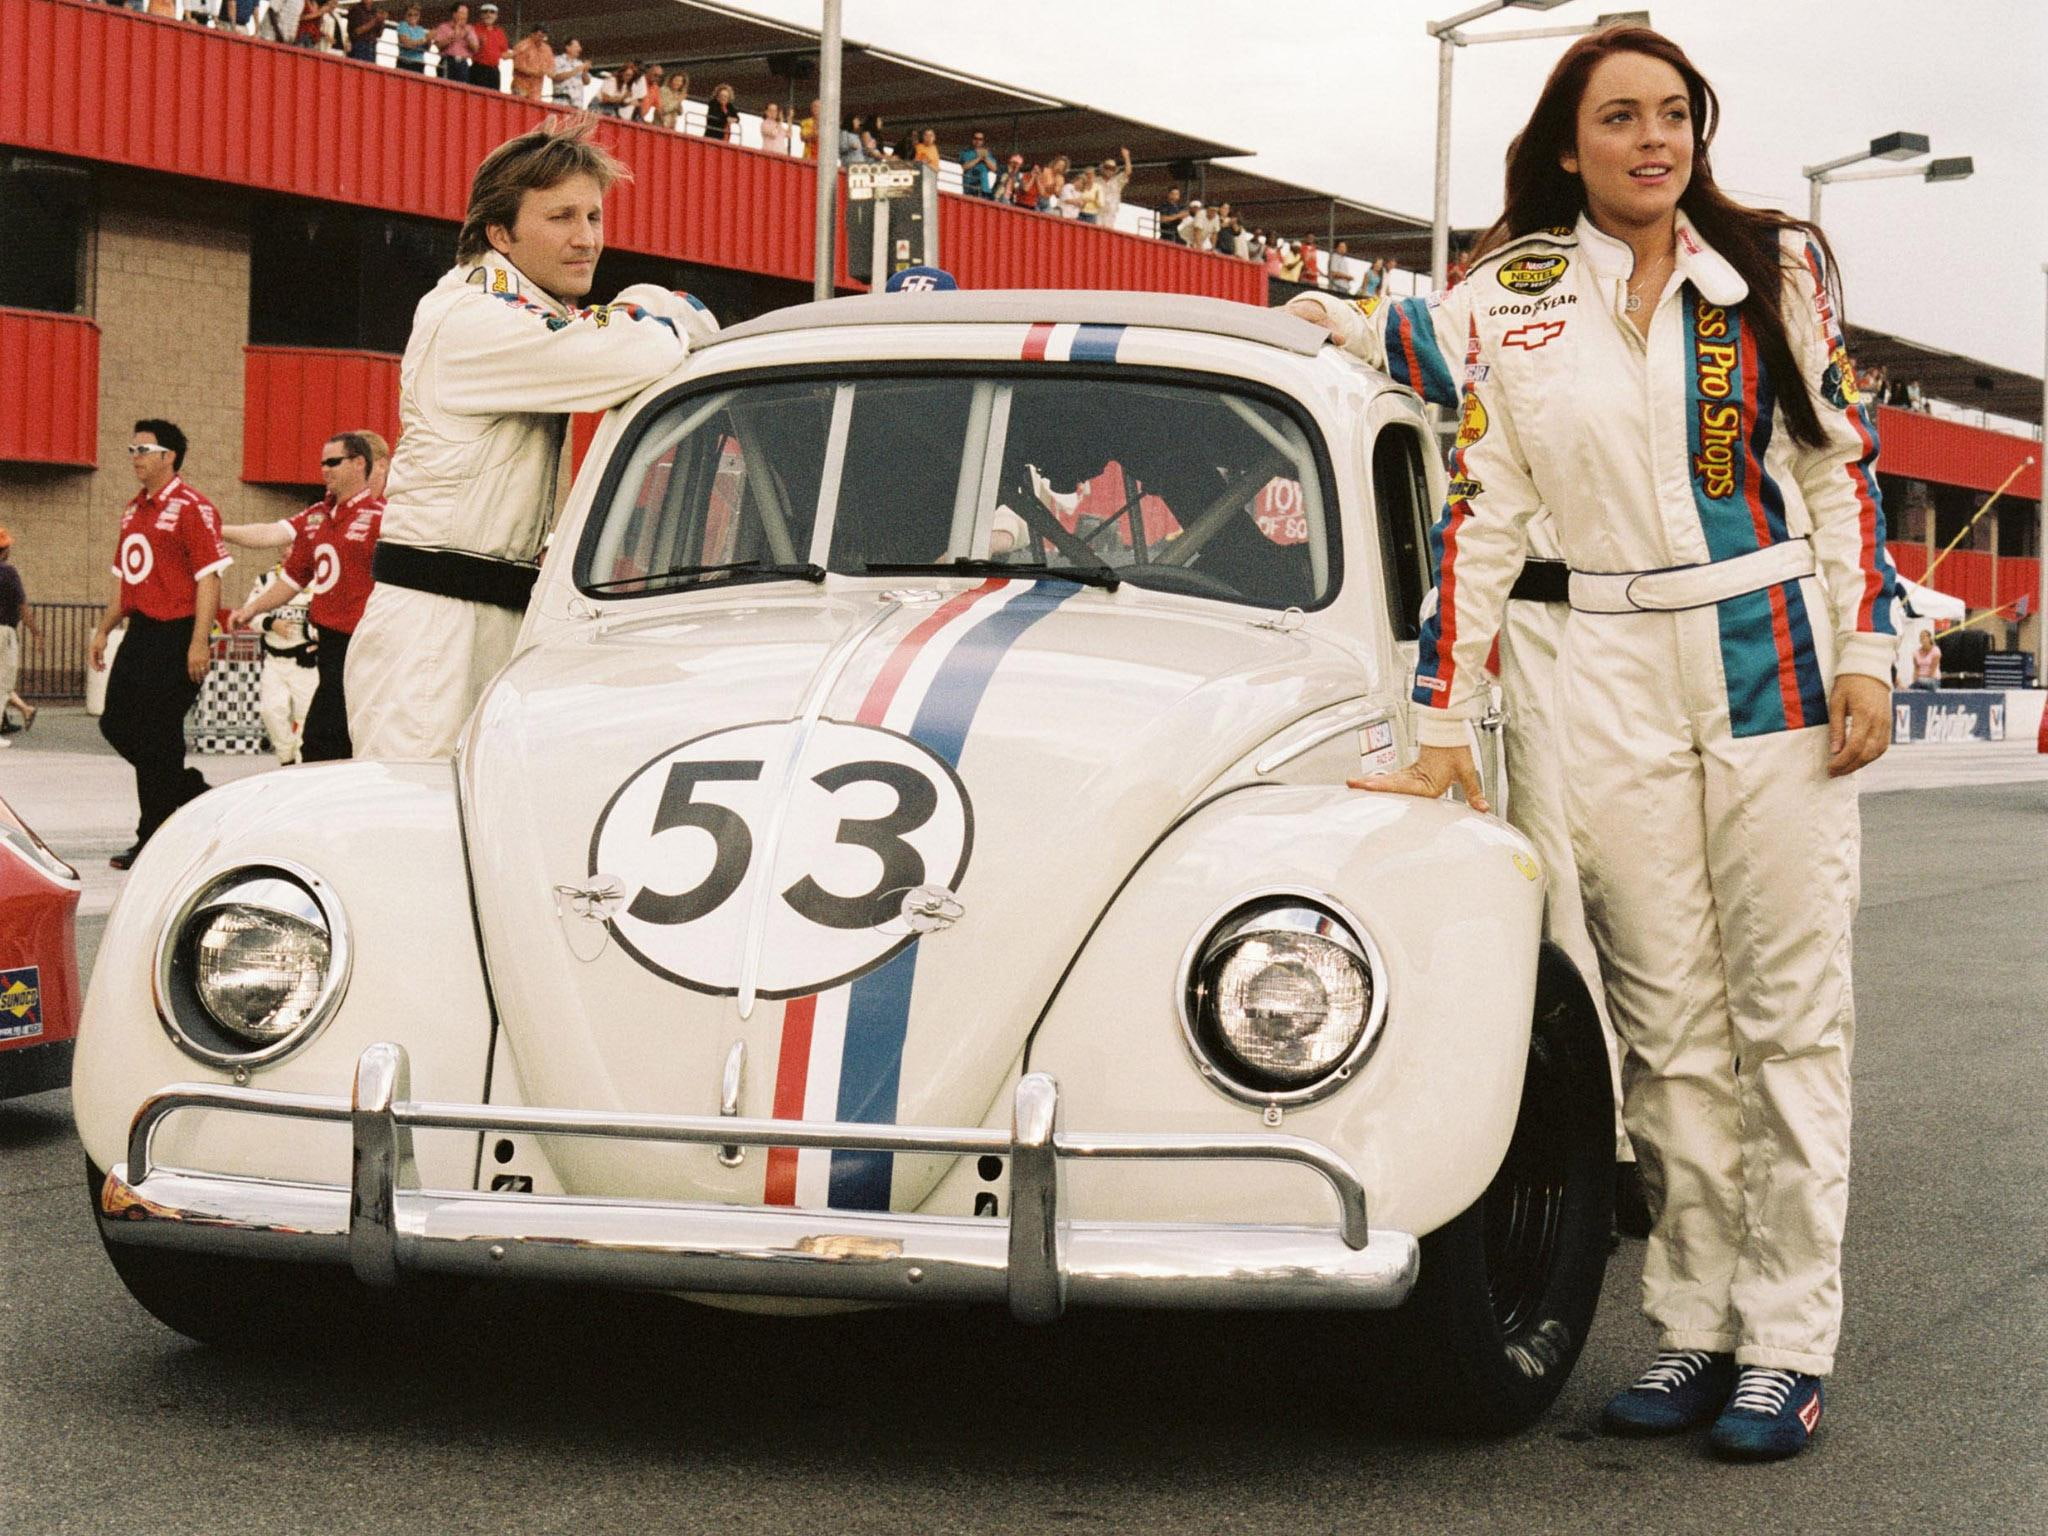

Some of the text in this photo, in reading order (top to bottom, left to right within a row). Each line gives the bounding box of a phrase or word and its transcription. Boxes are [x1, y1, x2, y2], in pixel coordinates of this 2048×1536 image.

[1511, 269, 1554, 281] NEXTEL
[1489, 294, 1578, 317] GOODYEAR
[1699, 341, 1737, 397] Pro
[1697, 403, 1741, 497] Shops
[627, 760, 938, 929] 53
